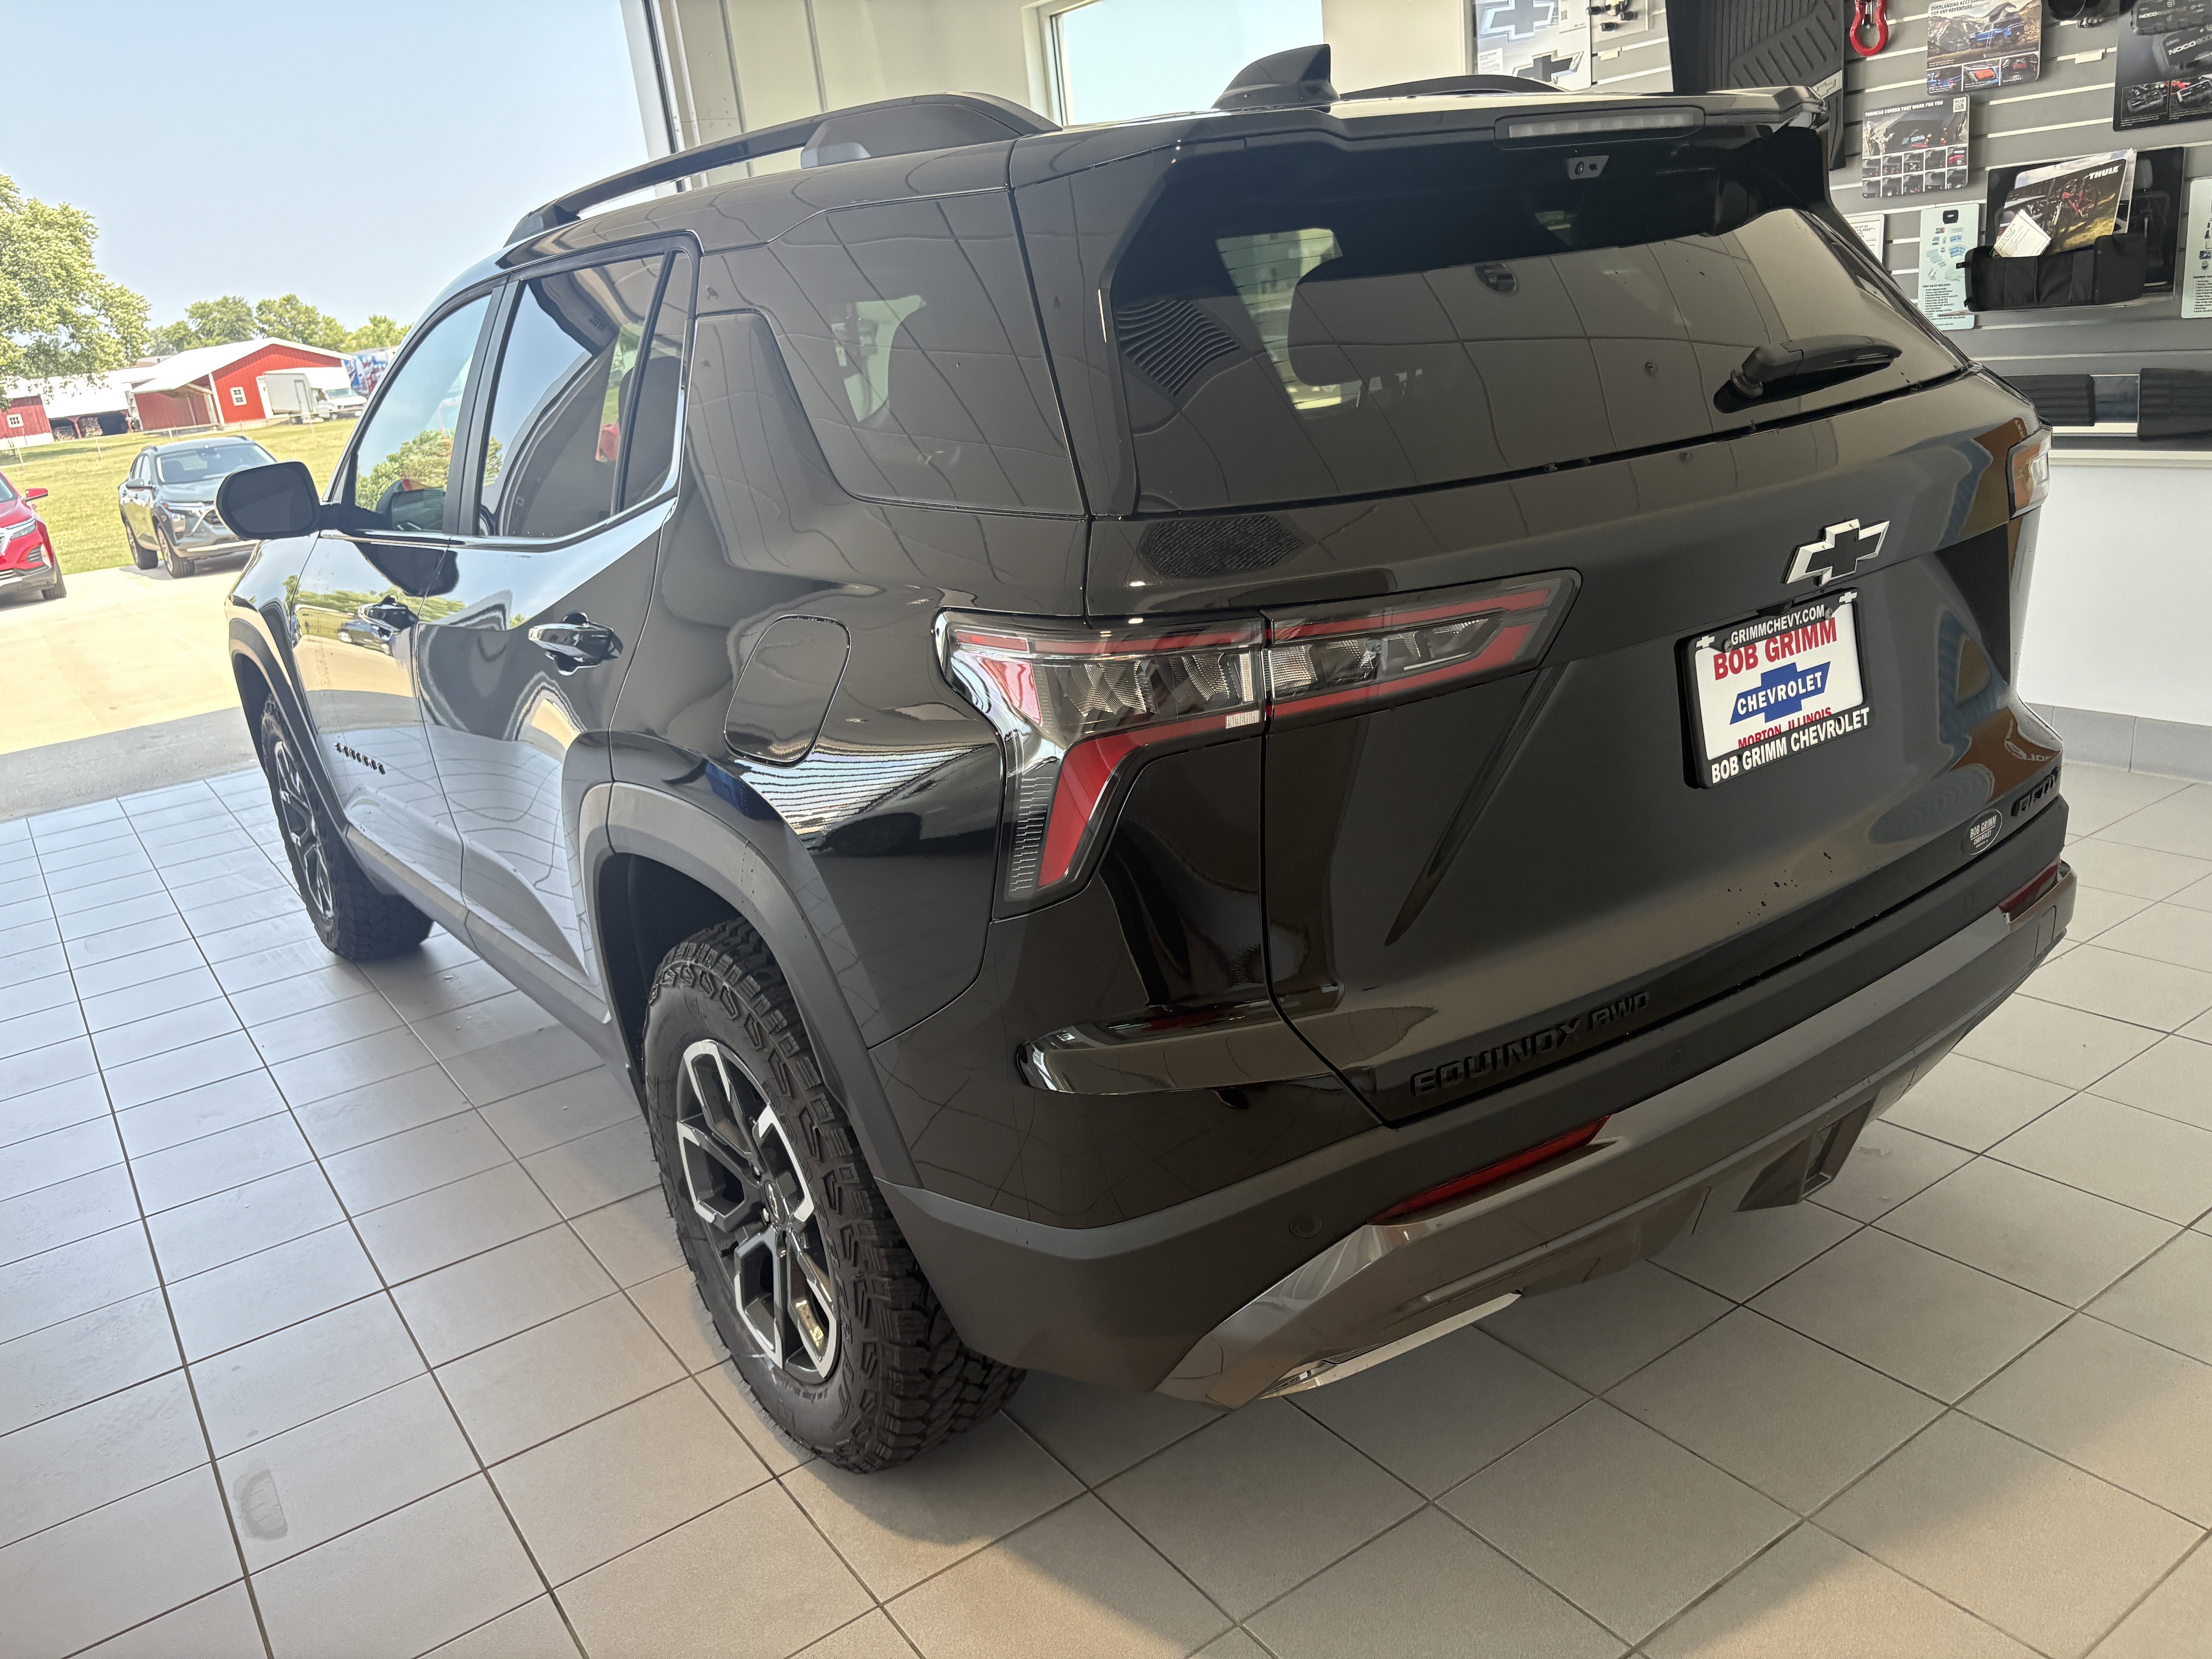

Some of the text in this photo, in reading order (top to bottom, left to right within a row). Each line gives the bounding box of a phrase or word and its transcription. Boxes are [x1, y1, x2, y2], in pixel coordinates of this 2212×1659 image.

[2168, 40, 2197, 55] NOCO
[2089, 165, 2119, 180] THULE
[1731, 604, 1824, 646] GRIMMCHEVY.COM
[1713, 617, 1837, 681] BOB GRIMM
[1737, 672, 1822, 715] CHEVROLET
[1711, 707, 1869, 784] BOB GRIMM CHEVROLET
[1738, 724, 1781, 749] MORTON
[1970, 815, 1997, 838] BOB GRIMM
[1973, 830, 1992, 845] CHEVROLET
[1411, 991, 1650, 1097] EQUINOX AWD
